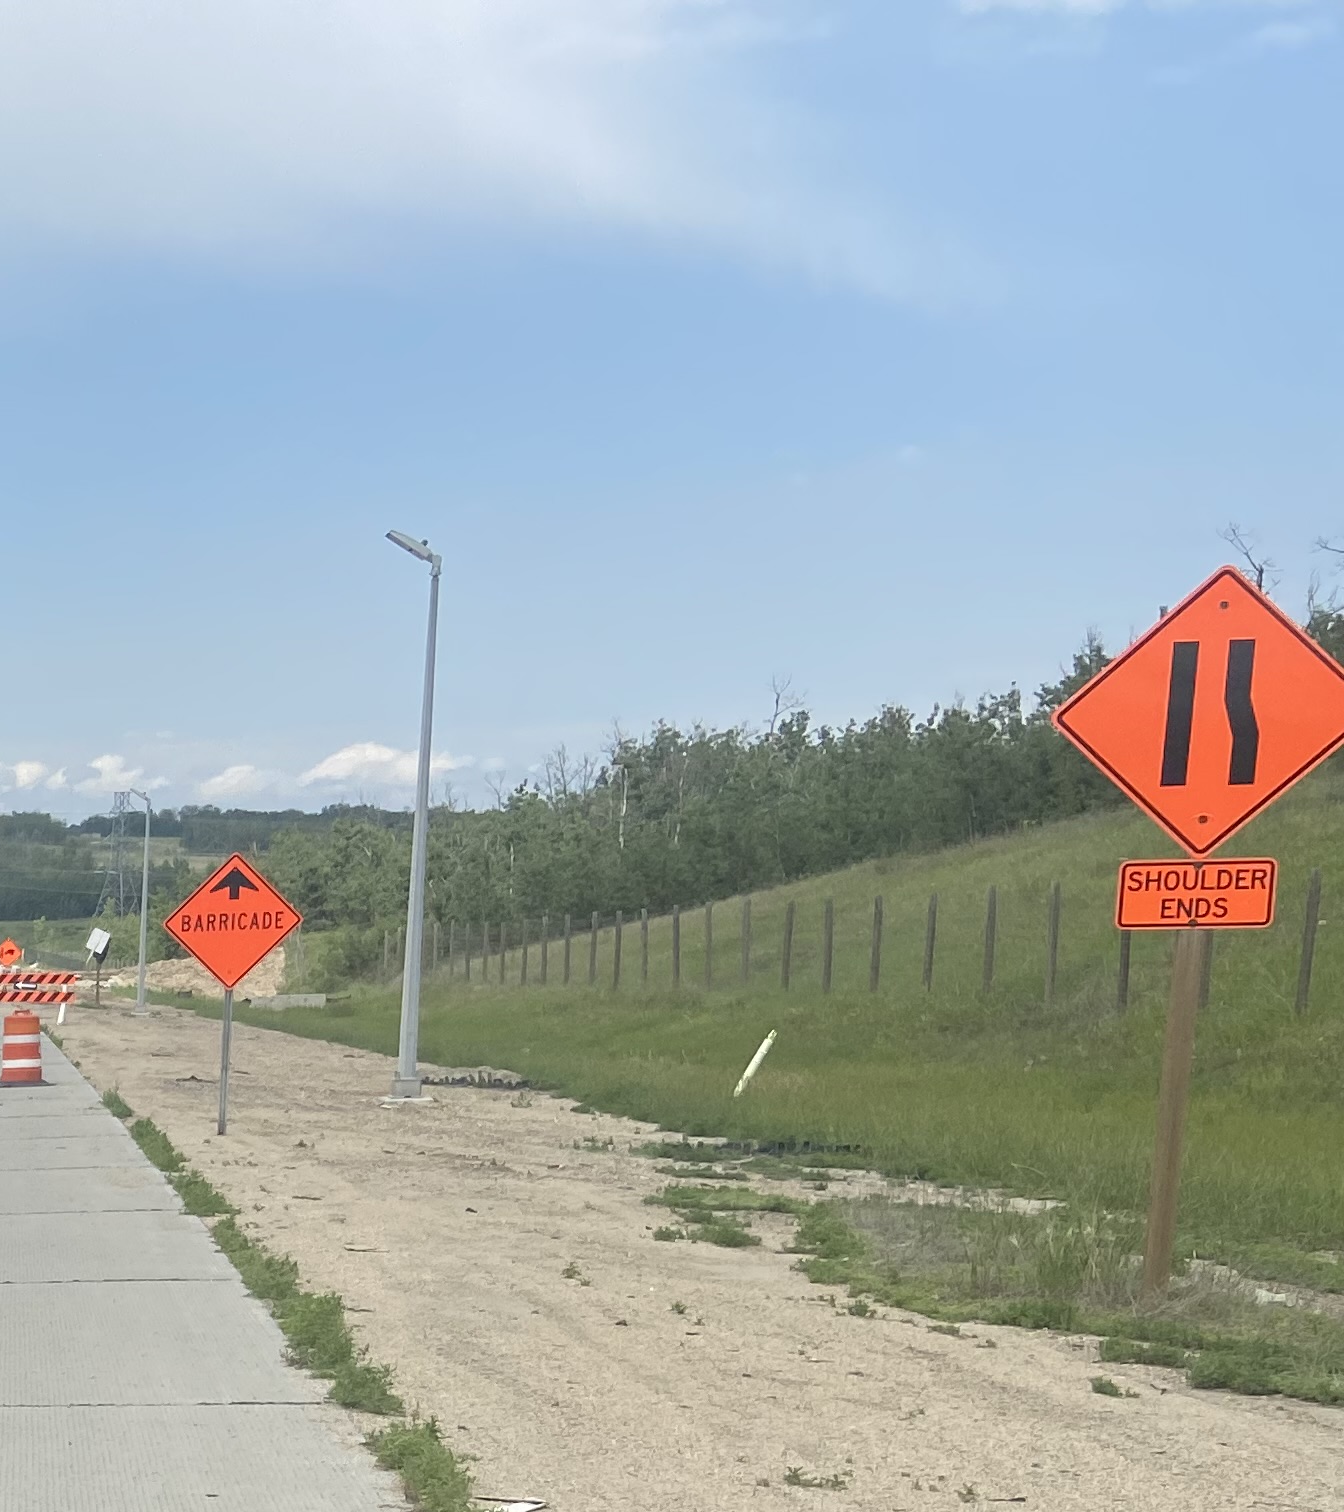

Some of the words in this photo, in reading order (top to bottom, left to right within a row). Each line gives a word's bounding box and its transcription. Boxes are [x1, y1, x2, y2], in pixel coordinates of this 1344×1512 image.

[1126, 869, 1267, 891] SHOULDER
[1160, 898, 1228, 919] ENDS
[181, 911, 284, 932] BARRICADE
